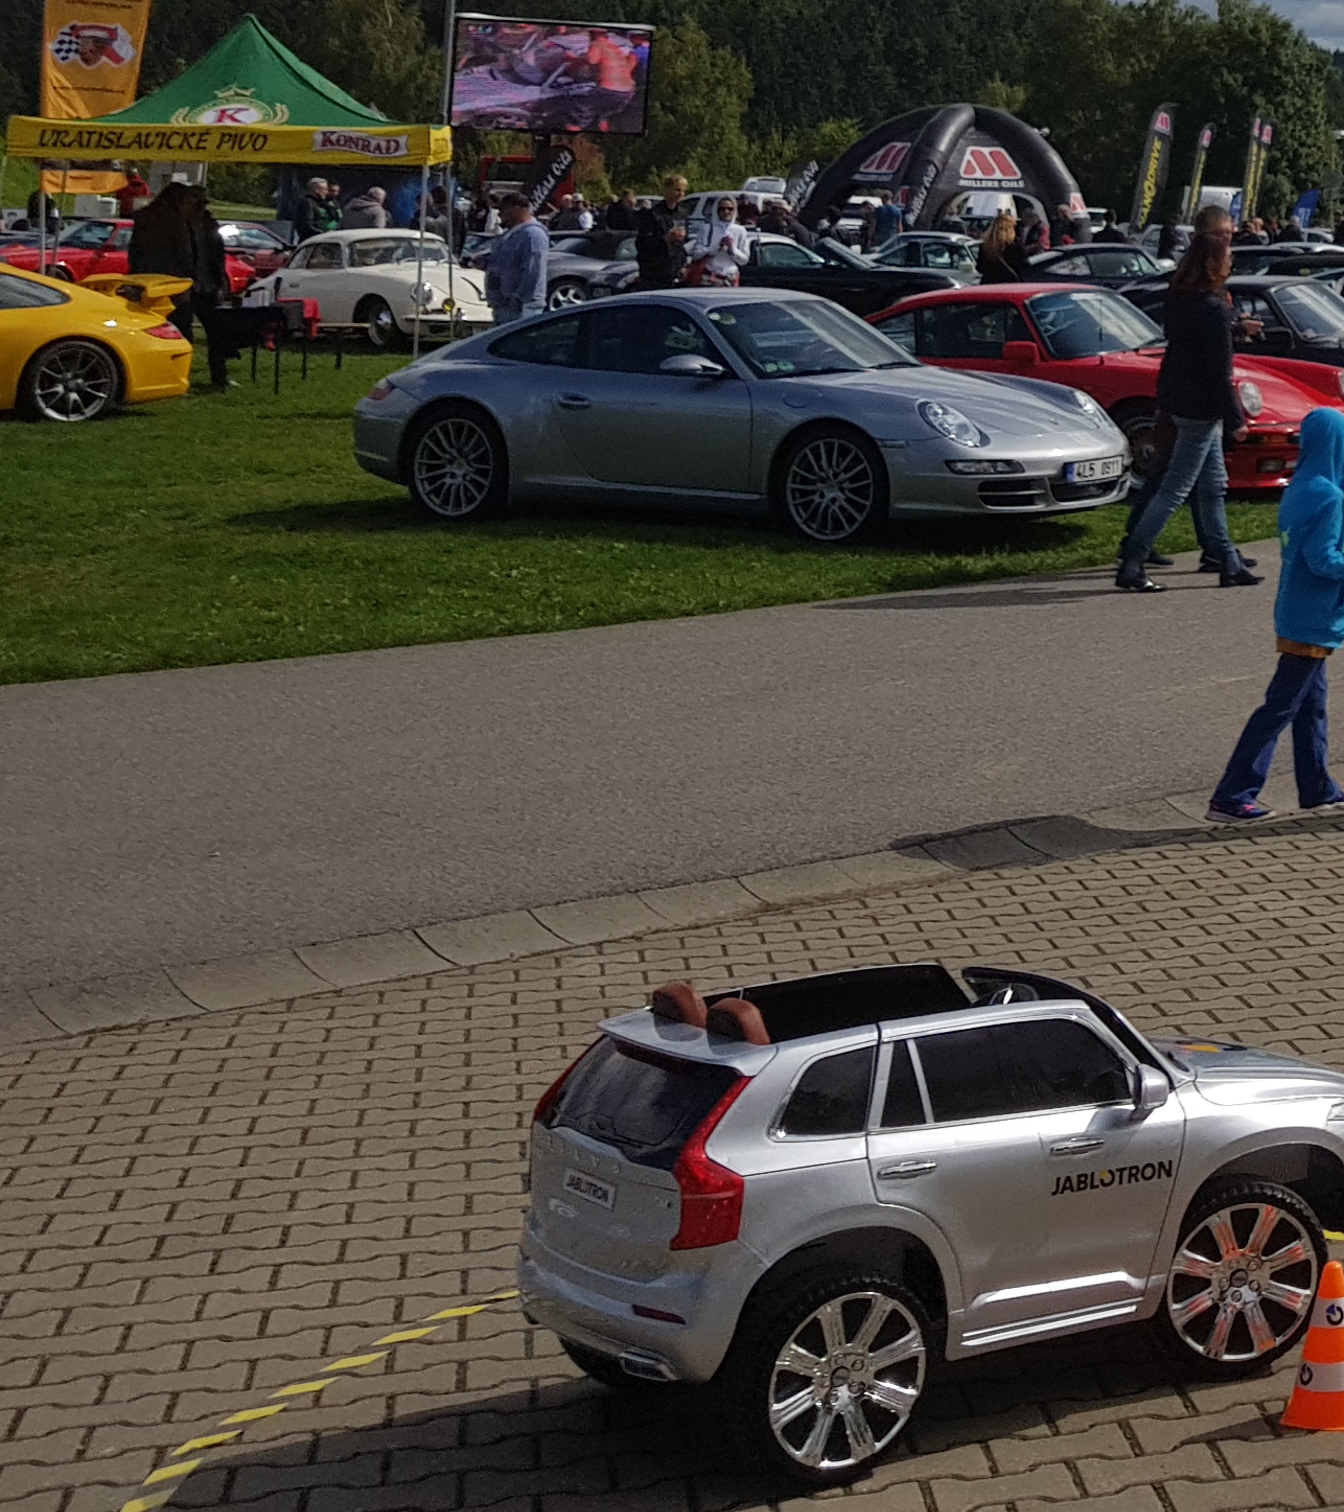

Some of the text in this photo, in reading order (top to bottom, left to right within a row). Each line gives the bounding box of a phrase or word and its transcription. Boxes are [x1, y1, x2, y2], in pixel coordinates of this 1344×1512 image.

[215, 131, 269, 152] PIVO
[320, 130, 400, 156] KONRAD
[959, 179, 1025, 188] MILLERS OILS
[1051, 1160, 1173, 1196] JABLOTRON
